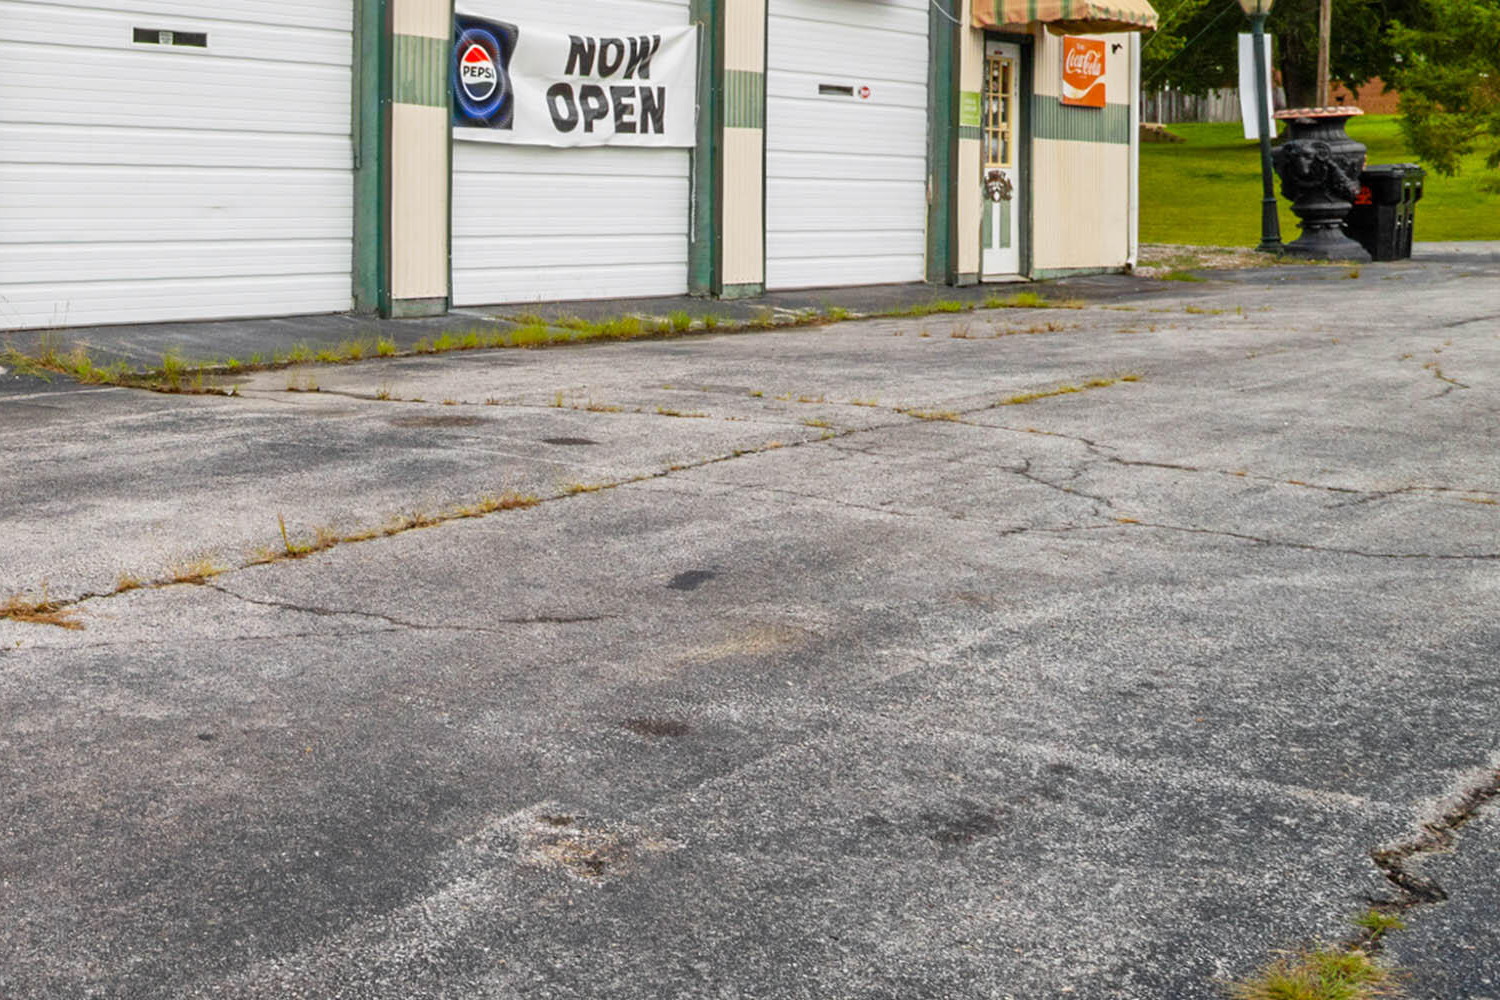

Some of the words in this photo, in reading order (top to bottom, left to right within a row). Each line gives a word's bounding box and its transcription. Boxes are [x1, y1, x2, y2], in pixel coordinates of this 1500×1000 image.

[463, 65, 495, 80] PEPSI
[564, 34, 660, 79] NOW
[546, 82, 666, 134] OPEN
